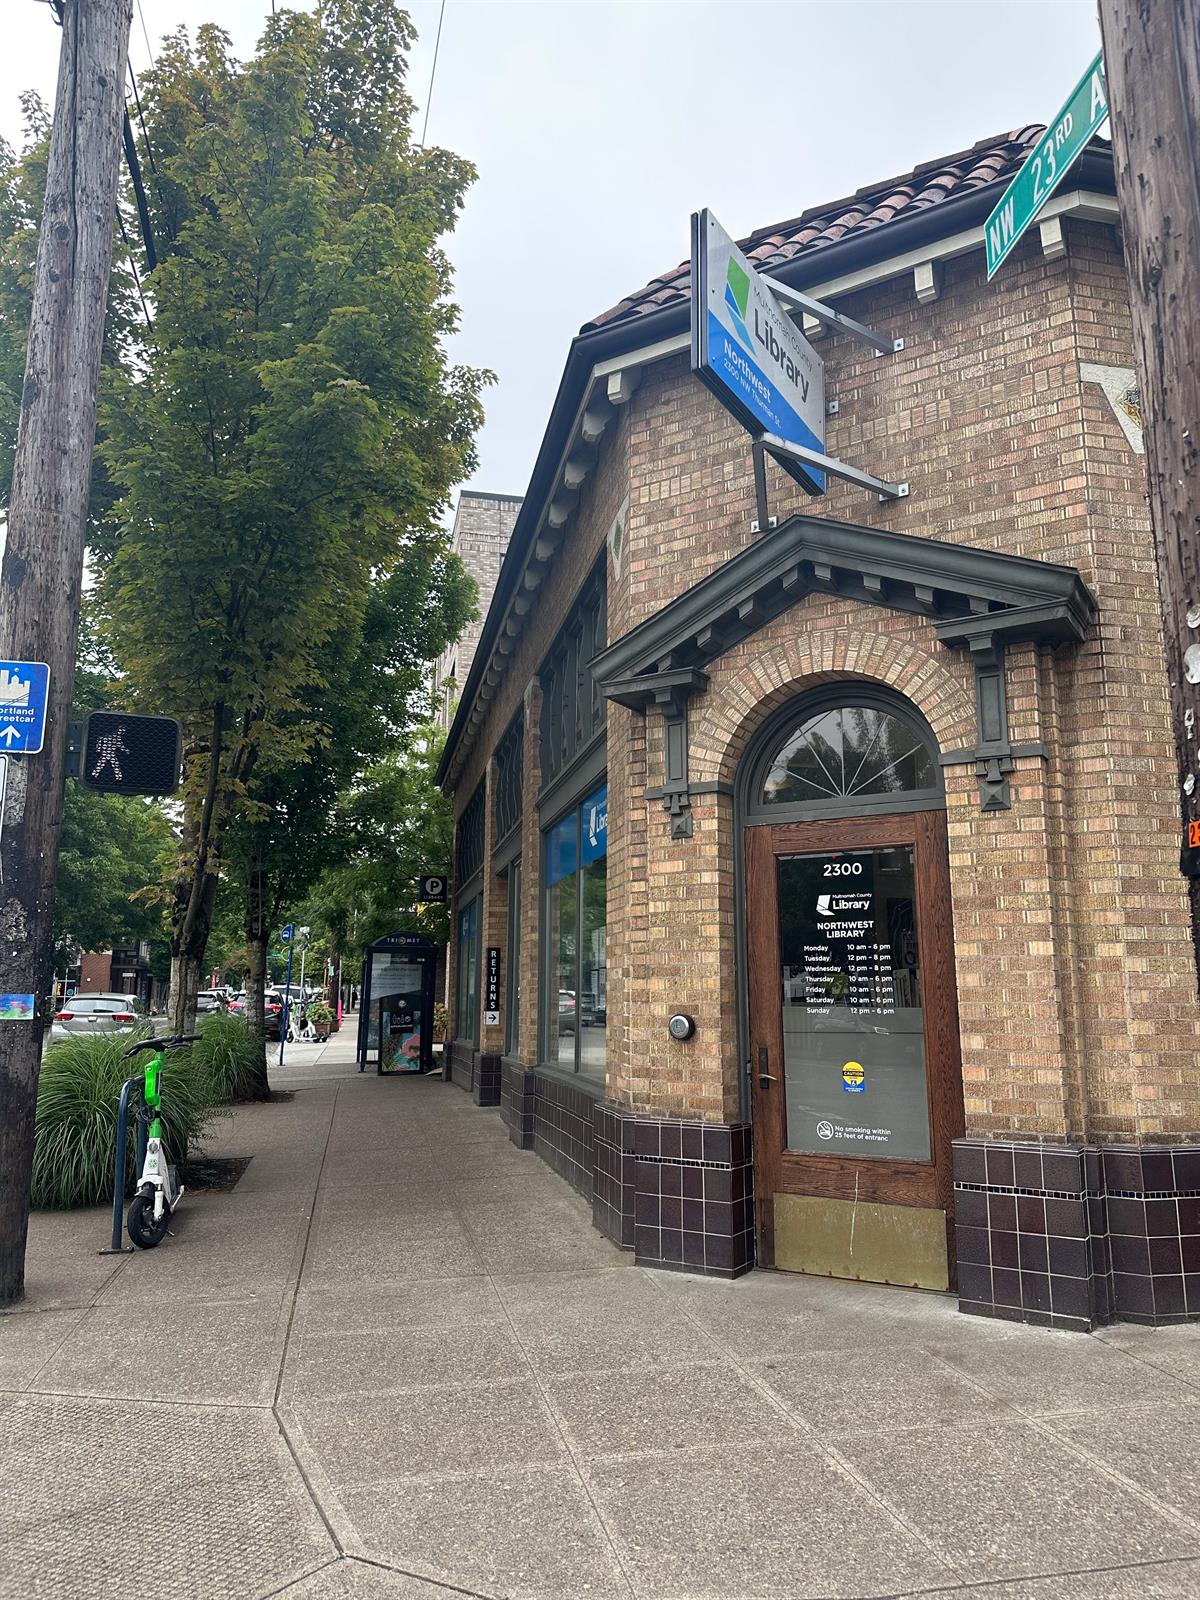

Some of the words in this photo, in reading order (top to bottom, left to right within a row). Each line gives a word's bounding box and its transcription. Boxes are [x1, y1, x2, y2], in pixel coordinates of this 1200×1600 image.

[989, 196, 1015, 264] NW
[1031, 112, 1073, 205] 23RD
[1090, 61, 1107, 124] A
[753, 286, 790, 342] Multnomah
[791, 336, 813, 372] County
[754, 308, 810, 403] Library
[724, 338, 771, 403] Northwest
[723, 358, 739, 381] 2300
[740, 377, 751, 393] NW
[751, 388, 774, 421] Thurman
[823, 862, 862, 876] 2300
[431, 880, 440, 892] P
[832, 899, 870, 910] Library
[817, 920, 875, 930] NORTHWEST
[826, 930, 865, 939] LIBRARY
[489, 950, 497, 1009] RETURNS
[805, 986, 826, 994] Friday
[806, 1007, 830, 1015] Sunday
[845, 1126, 871, 1134] smoking
